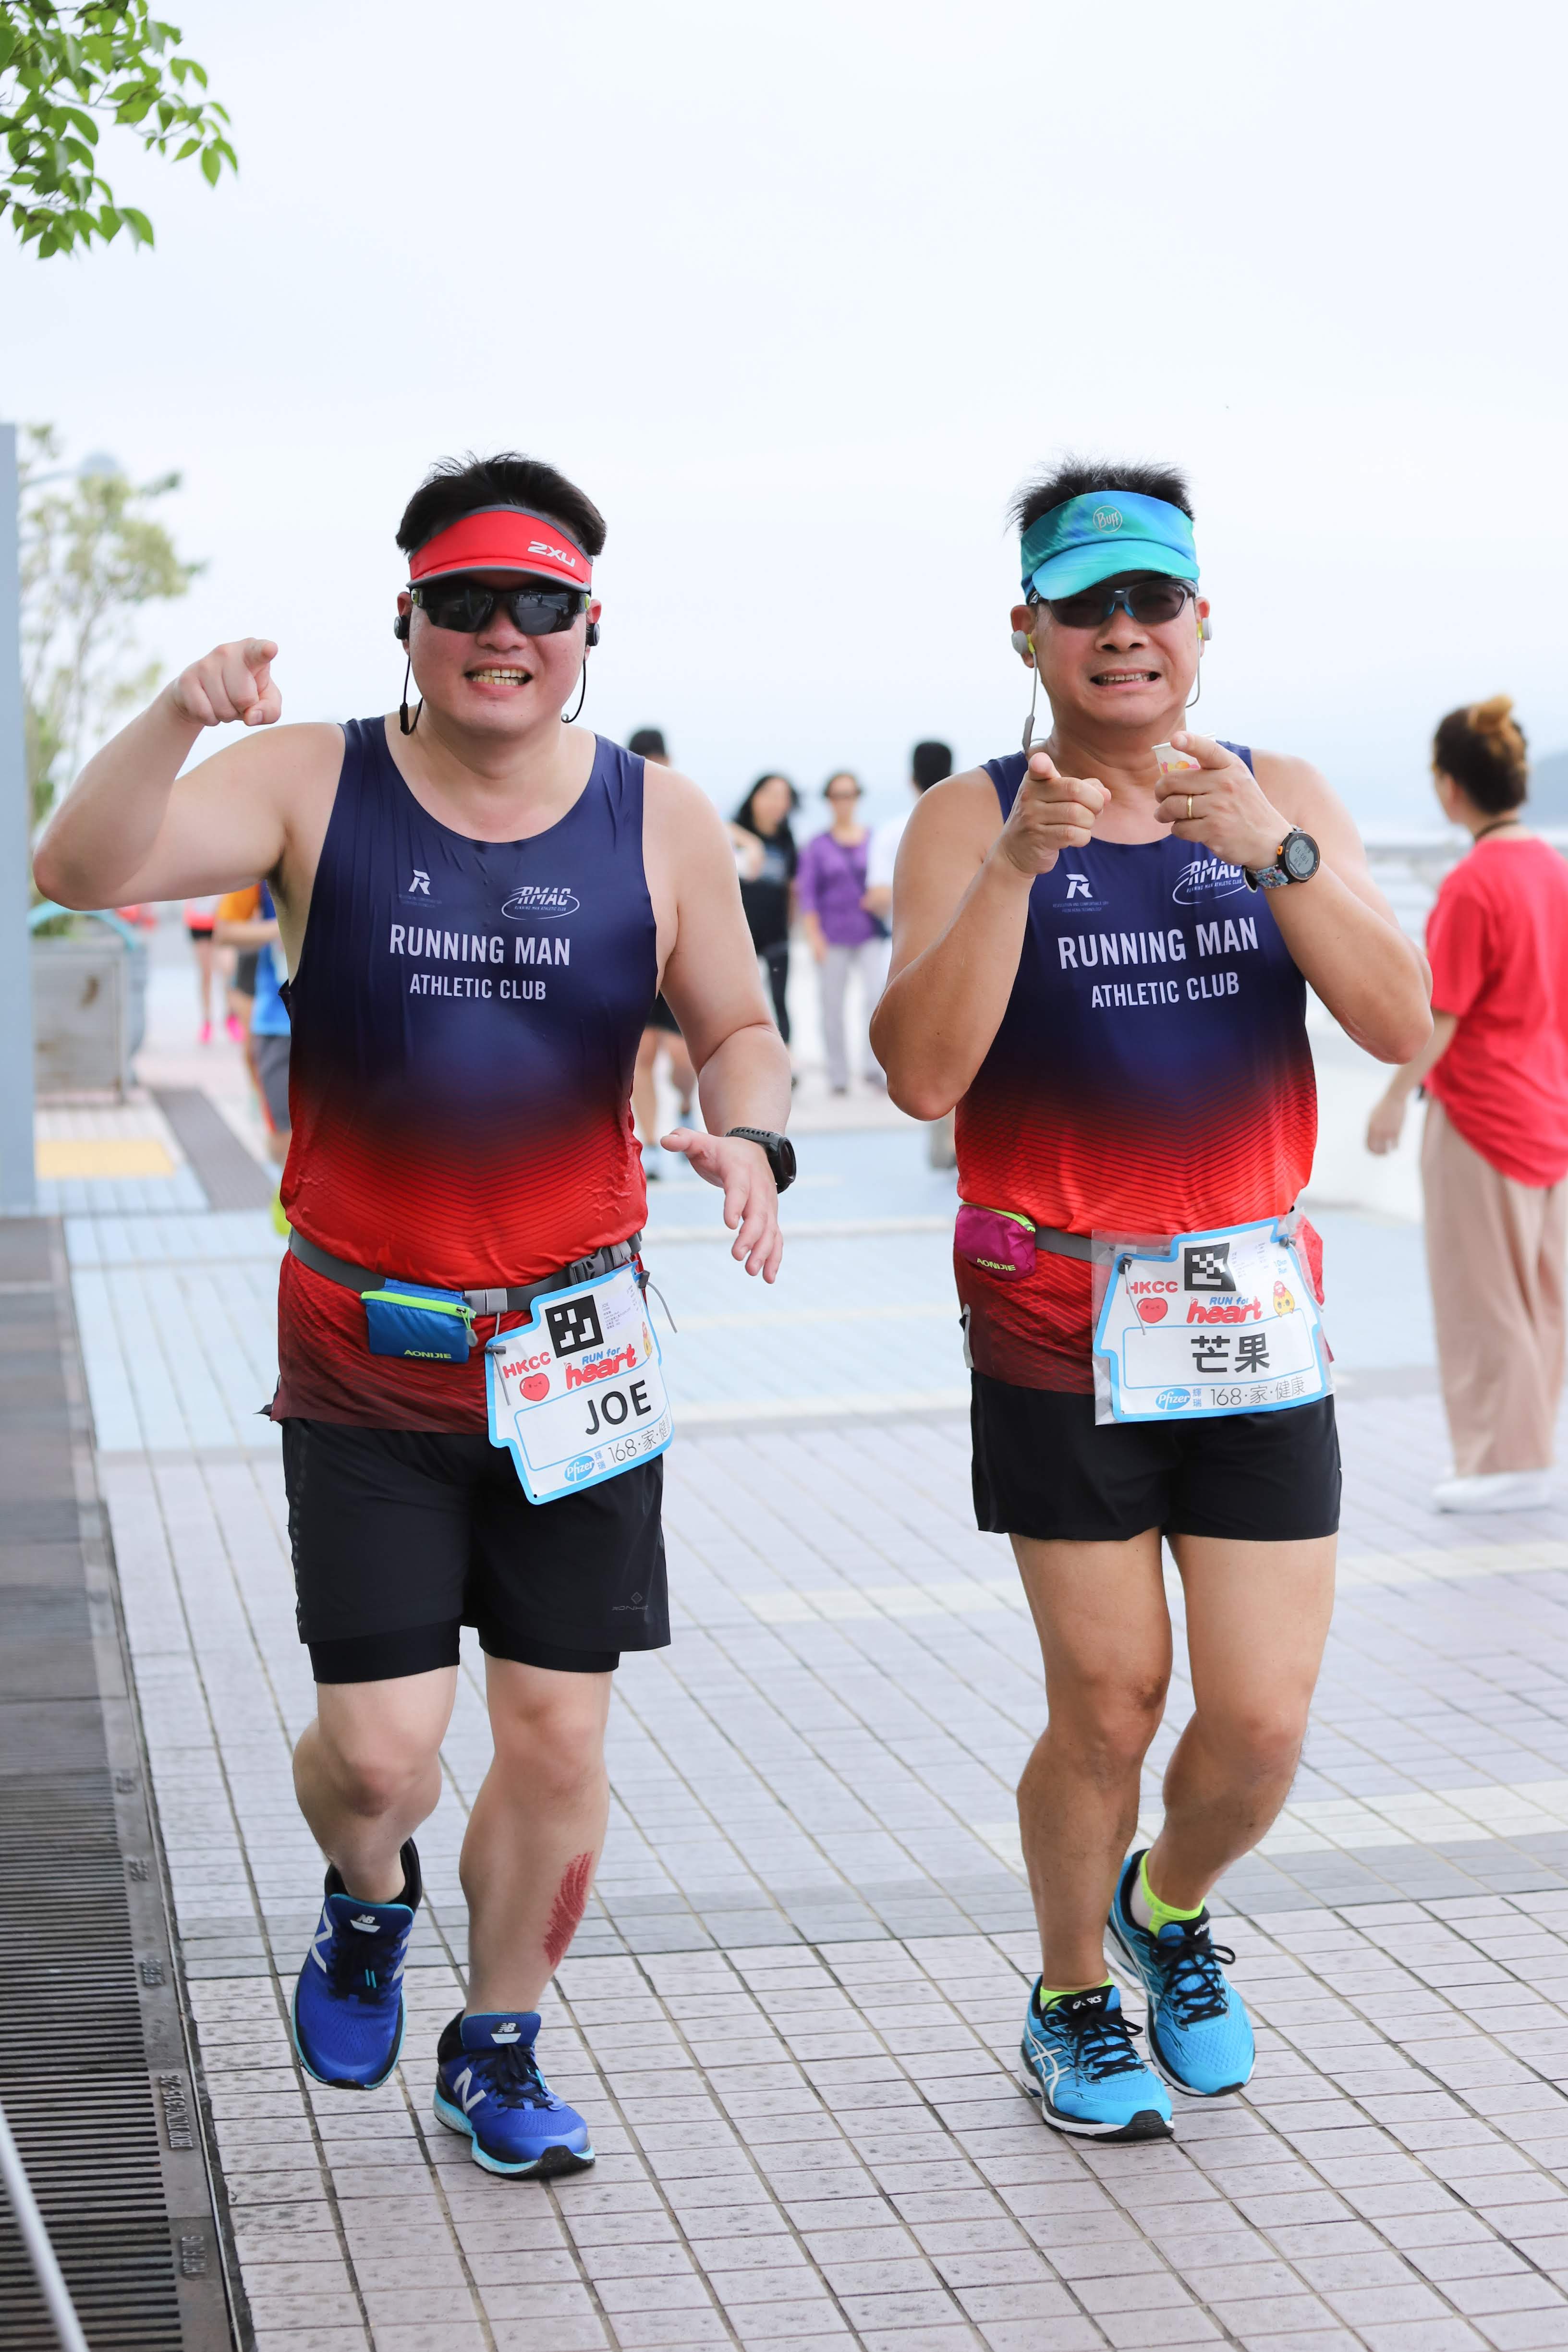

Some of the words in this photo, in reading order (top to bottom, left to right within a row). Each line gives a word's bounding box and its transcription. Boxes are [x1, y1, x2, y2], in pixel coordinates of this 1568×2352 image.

[527, 540, 576, 568] 2XU
[516, 886, 571, 906] RMAC
[389, 924, 504, 964] RUNNING
[515, 937, 571, 966] MAN
[1057, 929, 1186, 970] RUNNING
[1196, 917, 1259, 957] MAN
[410, 973, 492, 998] ATHLETIC
[500, 980, 546, 1000] CLUB
[1092, 981, 1179, 1008] ATHLETIC
[1187, 972, 1240, 1001] CLUB
[977, 1258, 1016, 1272] AONIJIE
[1126, 1281, 1178, 1294] HKCC
[1186, 1296, 1263, 1323] heart
[404, 1350, 452, 1359] AONIJIE
[502, 1352, 551, 1378] HKCC
[582, 1350, 604, 1365] RUN
[607, 1346, 621, 1358] for
[1191, 1333, 1270, 1373] 芒果
[565, 1344, 637, 1390] heart
[585, 1380, 651, 1435] JOE
[1158, 1391, 1190, 1409] Pfizer
[567, 1460, 595, 1481] Pfizer
